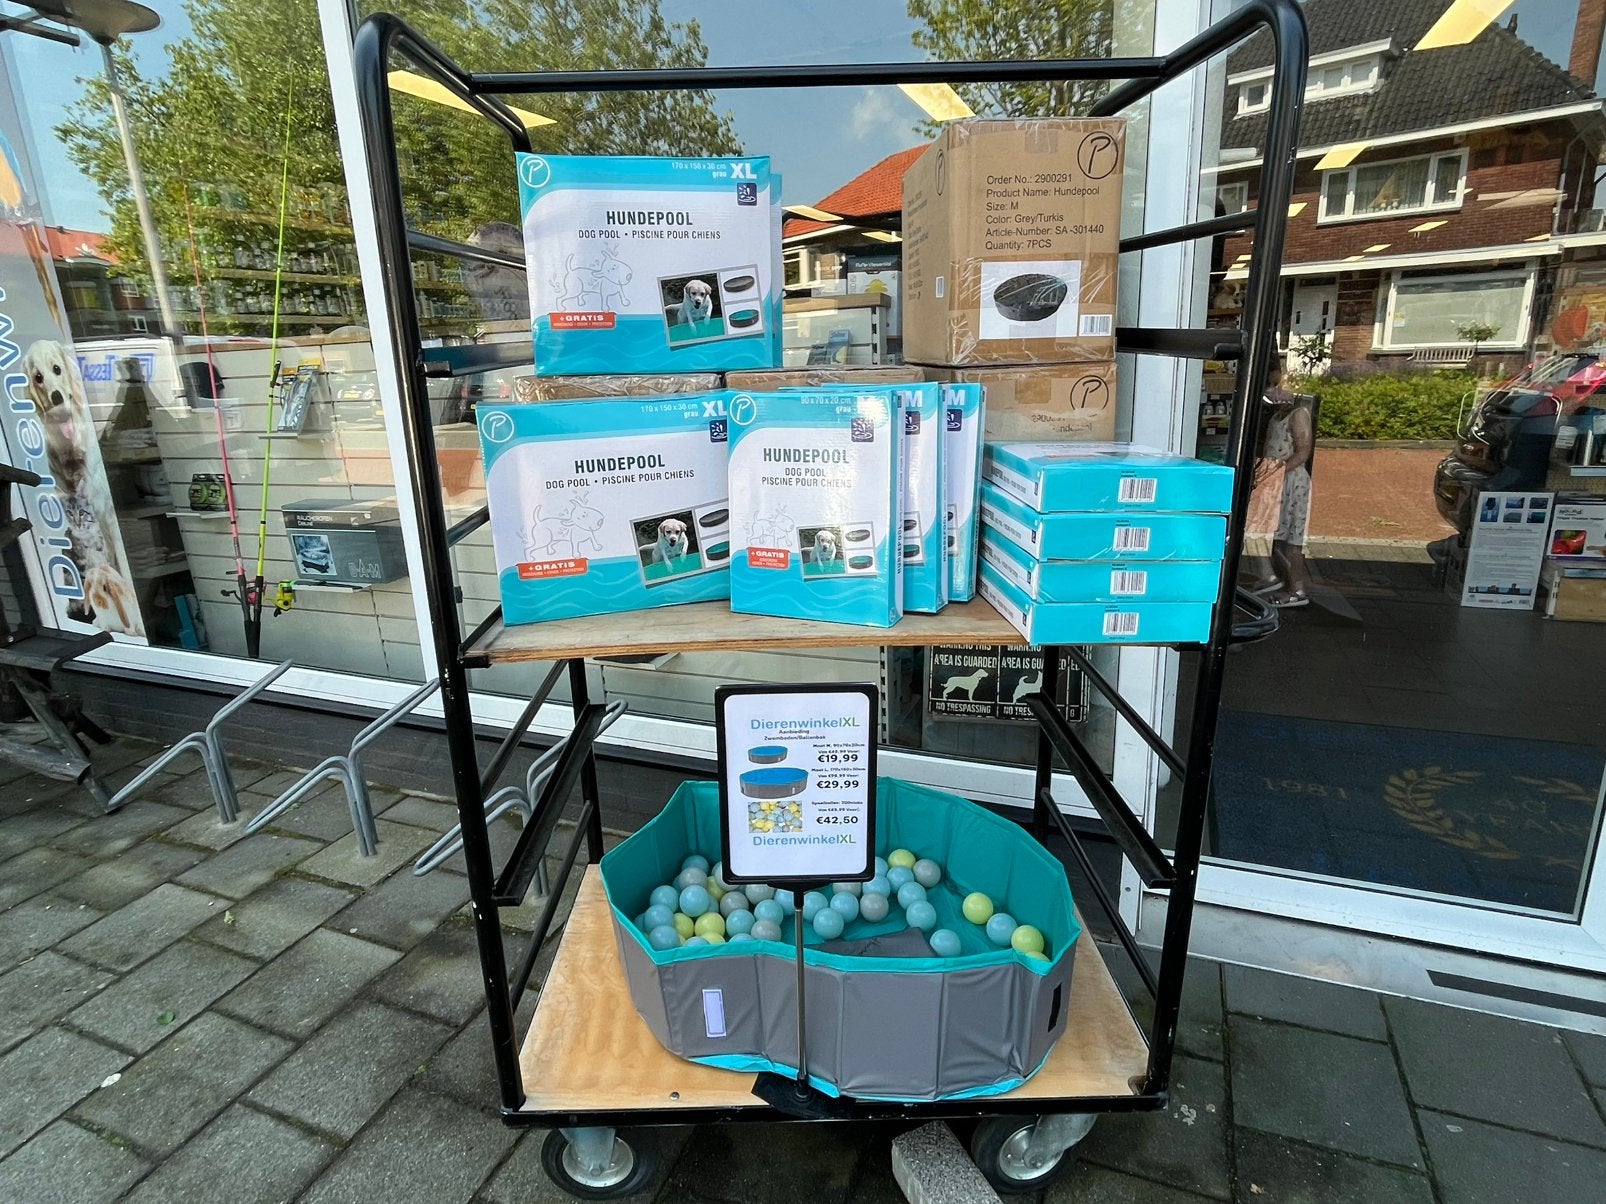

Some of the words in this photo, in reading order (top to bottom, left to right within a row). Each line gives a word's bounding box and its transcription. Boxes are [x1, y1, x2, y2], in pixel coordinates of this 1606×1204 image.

[712, 171, 727, 179] grau
[730, 162, 757, 180] XL
[986, 175, 1012, 185] Order
[1014, 174, 1032, 184] No.:
[1034, 173, 1072, 184] 2900291
[986, 188, 1020, 198] Product
[1022, 188, 1050, 197] Name:
[1054, 186, 1100, 198] Hundepool
[986, 202, 1008, 211] Size:
[1010, 201, 1019, 210] M
[606, 210, 693, 226] HUNDEPOOL
[985, 215, 1012, 224] Color:
[1014, 213, 1064, 225] Grey/Turkis
[578, 230, 596, 239] DOG
[599, 230, 620, 239] POOL
[632, 230, 664, 239] PISCINE
[667, 230, 690, 239] POUR
[692, 231, 721, 239] CHIENS
[985, 226, 1052, 237] Article-Number:
[985, 240, 1024, 251] Quantity:
[1027, 239, 1052, 248] 7PCS
[905, 390, 923, 408] M
[948, 389, 965, 406] M
[660, 404, 672, 412] 150
[702, 400, 728, 418] XL
[835, 406, 851, 414] grau
[684, 411, 699, 419] grau
[0, 286, 85, 599] Dierenw
[763, 448, 850, 464] HUNDEPOOL
[574, 454, 666, 474] HUNDEPOOL
[784, 467, 802, 476] DOG
[804, 468, 826, 477] POOL
[545, 480, 564, 489] DOG
[567, 478, 590, 488] POOL
[602, 475, 636, 485] PISCINE
[638, 472, 662, 482] POUR
[664, 469, 695, 480] CHIENS
[761, 477, 793, 486] PISCINE
[795, 478, 818, 487] POUR
[820, 478, 852, 488] CHIENS
[934, 654, 954, 666] AREA
[954, 655, 962, 667] IS
[963, 656, 998, 669] GUARDED
[1001, 656, 1021, 669] AREA
[1022, 658, 1030, 669] IS
[946, 702, 991, 714] TRESPASSING
[751, 716, 860, 730] DierenwinkelXL
[818, 754, 858, 764] €19,99
[817, 780, 859, 789] €29,99
[816, 816, 858, 825] €42,50
[752, 834, 857, 846] DierenwinkelXL
